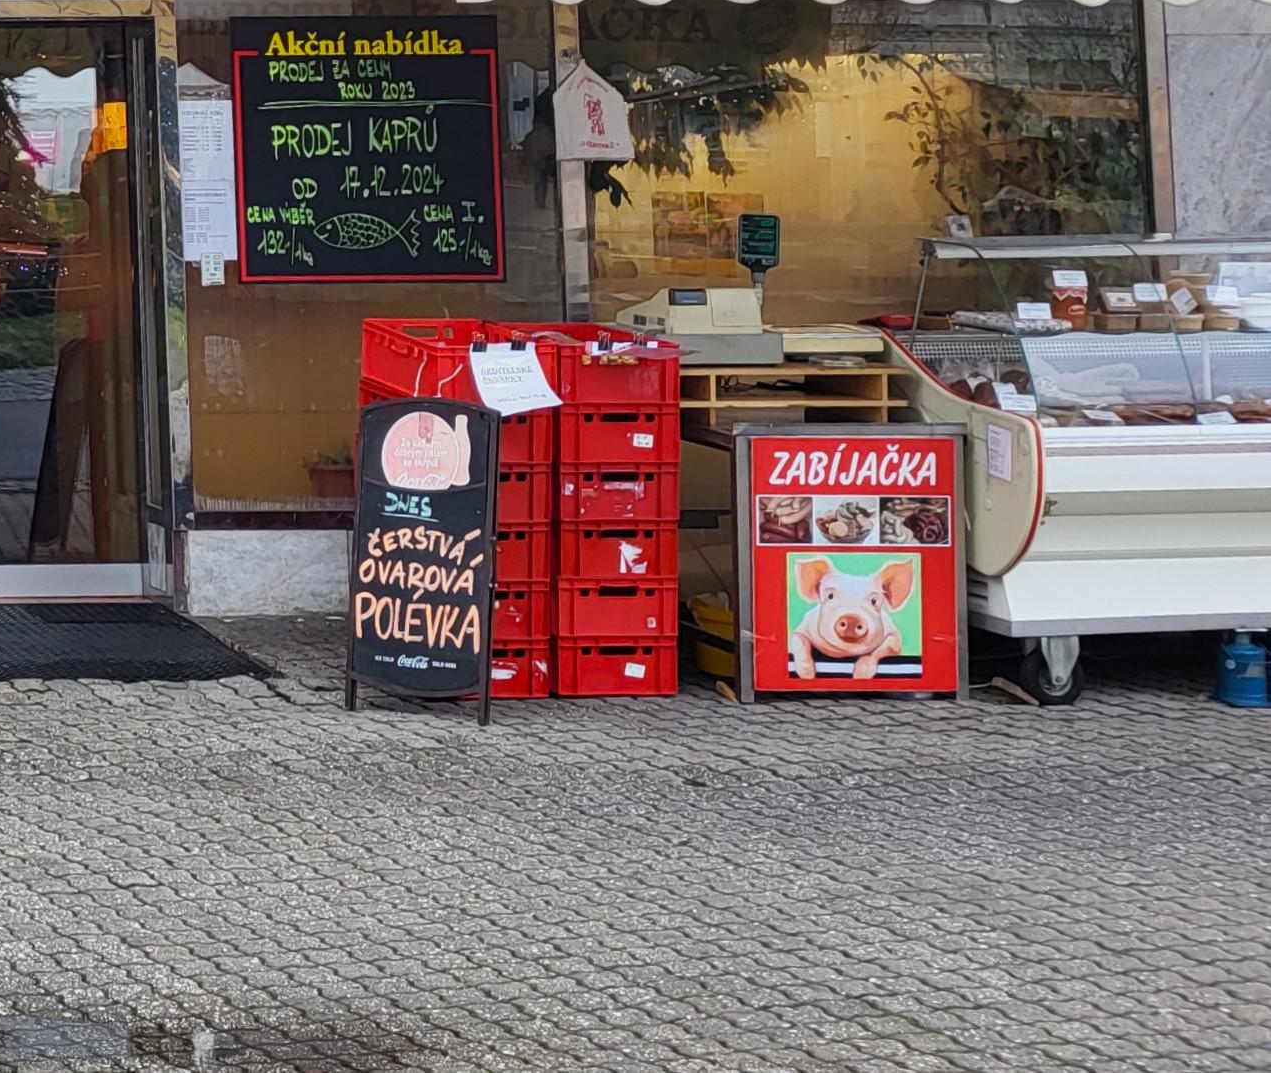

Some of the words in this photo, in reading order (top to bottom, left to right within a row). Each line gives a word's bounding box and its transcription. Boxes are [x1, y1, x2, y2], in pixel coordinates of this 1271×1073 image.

[264, 30, 347, 56] Akční
[353, 29, 465, 56] nabídka
[269, 59, 324, 83] PRODEJ
[332, 59, 350, 81] ZA
[338, 82, 373, 100] ROKU
[381, 81, 416, 100] 2023
[271, 119, 352, 161] PRODEJ
[368, 104, 438, 154] KAPRŮ
[291, 177, 318, 200] OD
[340, 163, 445, 199] 17.12.2024
[247, 205, 277, 223] CENA
[423, 203, 455, 224] CENA
[768, 442, 937, 487] ZABÍJAČKA
[384, 491, 432, 518] DNES
[367, 526, 482, 566] ČERSTVÁ
[359, 553, 484, 596] OVAROVÁ
[355, 588, 481, 655] POLÉVKA
